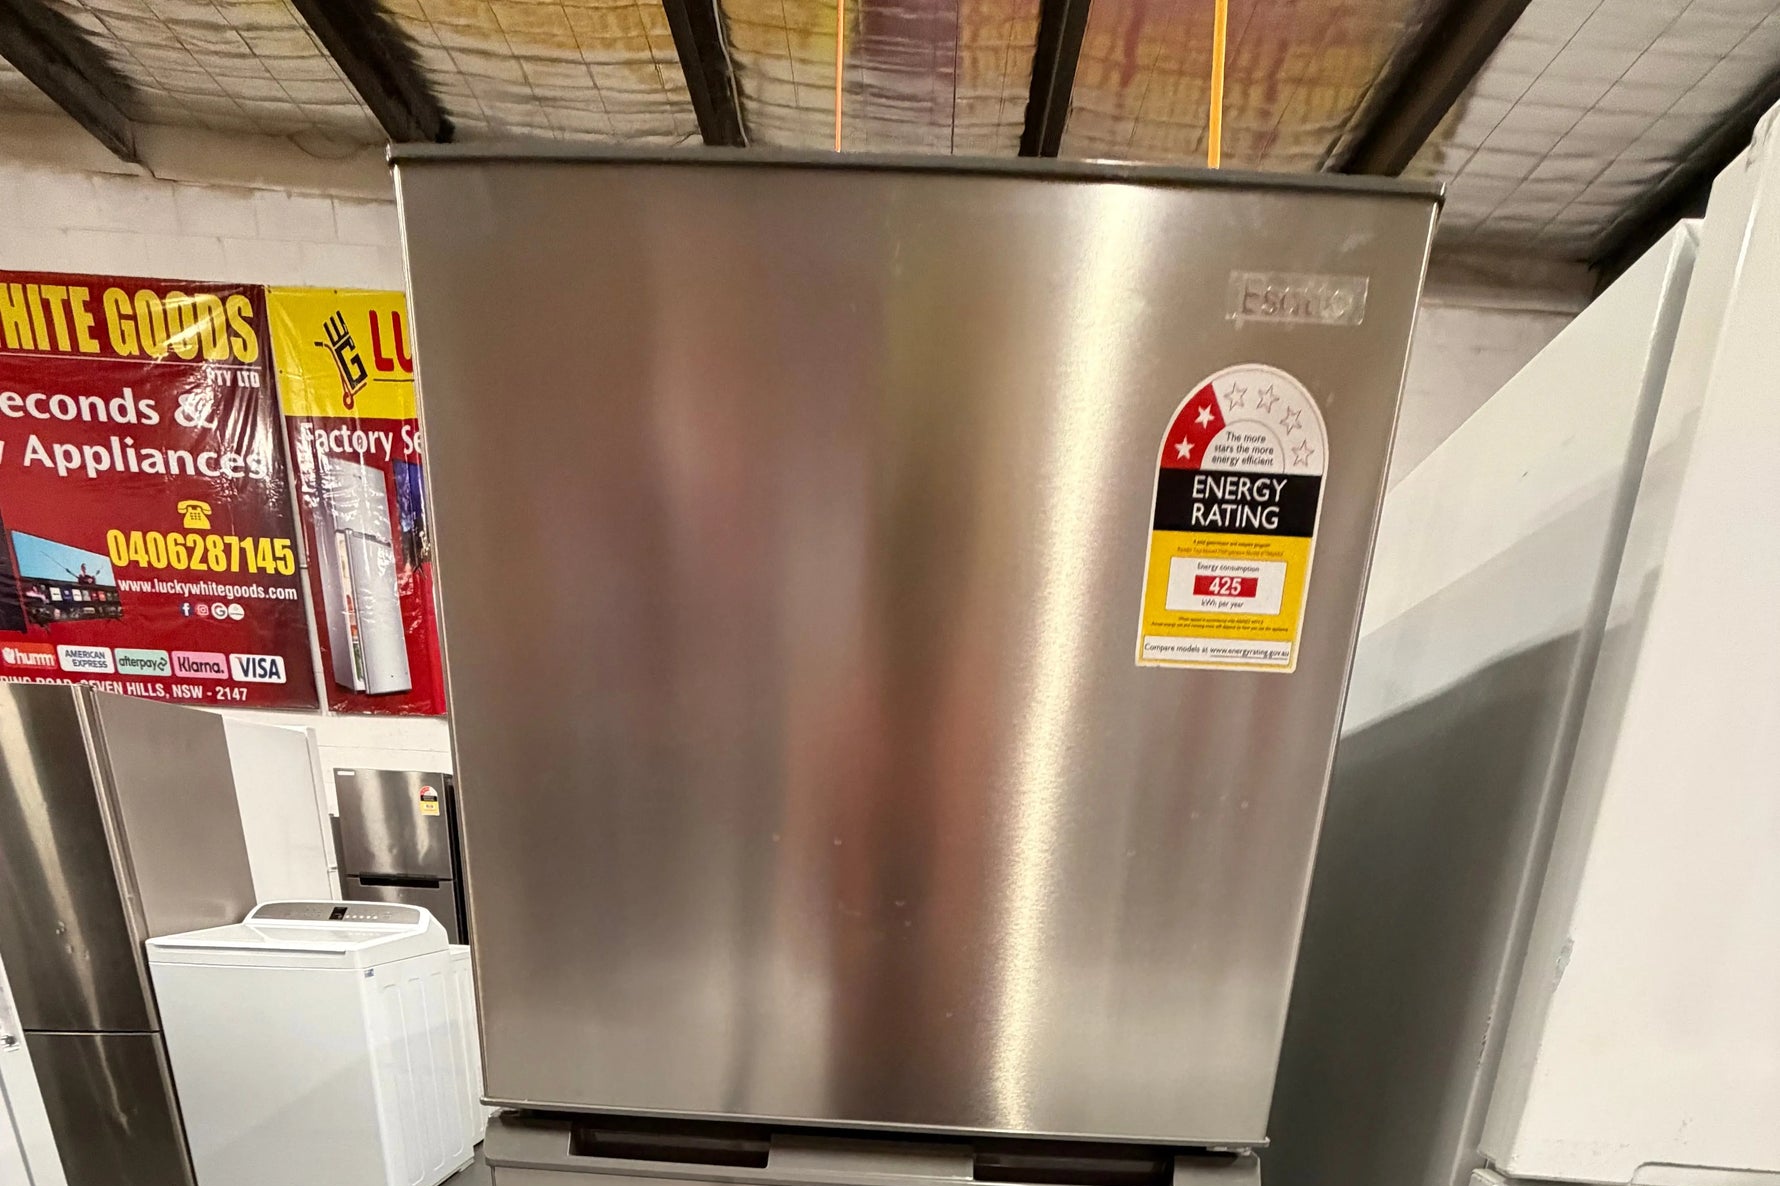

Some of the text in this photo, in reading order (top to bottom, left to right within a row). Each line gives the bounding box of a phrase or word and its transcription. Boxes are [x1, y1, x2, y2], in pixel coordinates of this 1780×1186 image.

[0, 283, 259, 363] HITE GOODS
[206, 370, 261, 388] PTY LTD
[174, 393, 218, 428] &
[300, 423, 393, 462] Factory
[1226, 431, 1266, 443] The more
[23, 434, 268, 479] Appliances
[1214, 444, 1274, 455] stars the more
[1211, 455, 1274, 467] energy efficient
[1192, 475, 1288, 502] ENERGY
[1191, 502, 1280, 530] RATING
[106, 529, 296, 576] 0406287145
[1197, 562, 1260, 573] Energy consumption
[118, 578, 298, 600] www.luckywhitegoods.com
[1209, 577, 1242, 595] 425
[1218, 601, 1229, 609] per
[1230, 602, 1244, 610] year
[15, 648, 55, 667] humm
[65, 649, 106, 660] AMERICAN
[1144, 643, 1175, 653] Compare
[1176, 644, 1200, 654] models
[72, 659, 108, 669] EXPRESS
[118, 655, 158, 671] afterpay
[177, 656, 225, 674] Klarna.
[235, 656, 281, 680] VISA
[126, 682, 169, 699] HILLS,
[172, 684, 203, 699] NSW
[216, 686, 248, 701] 2147
